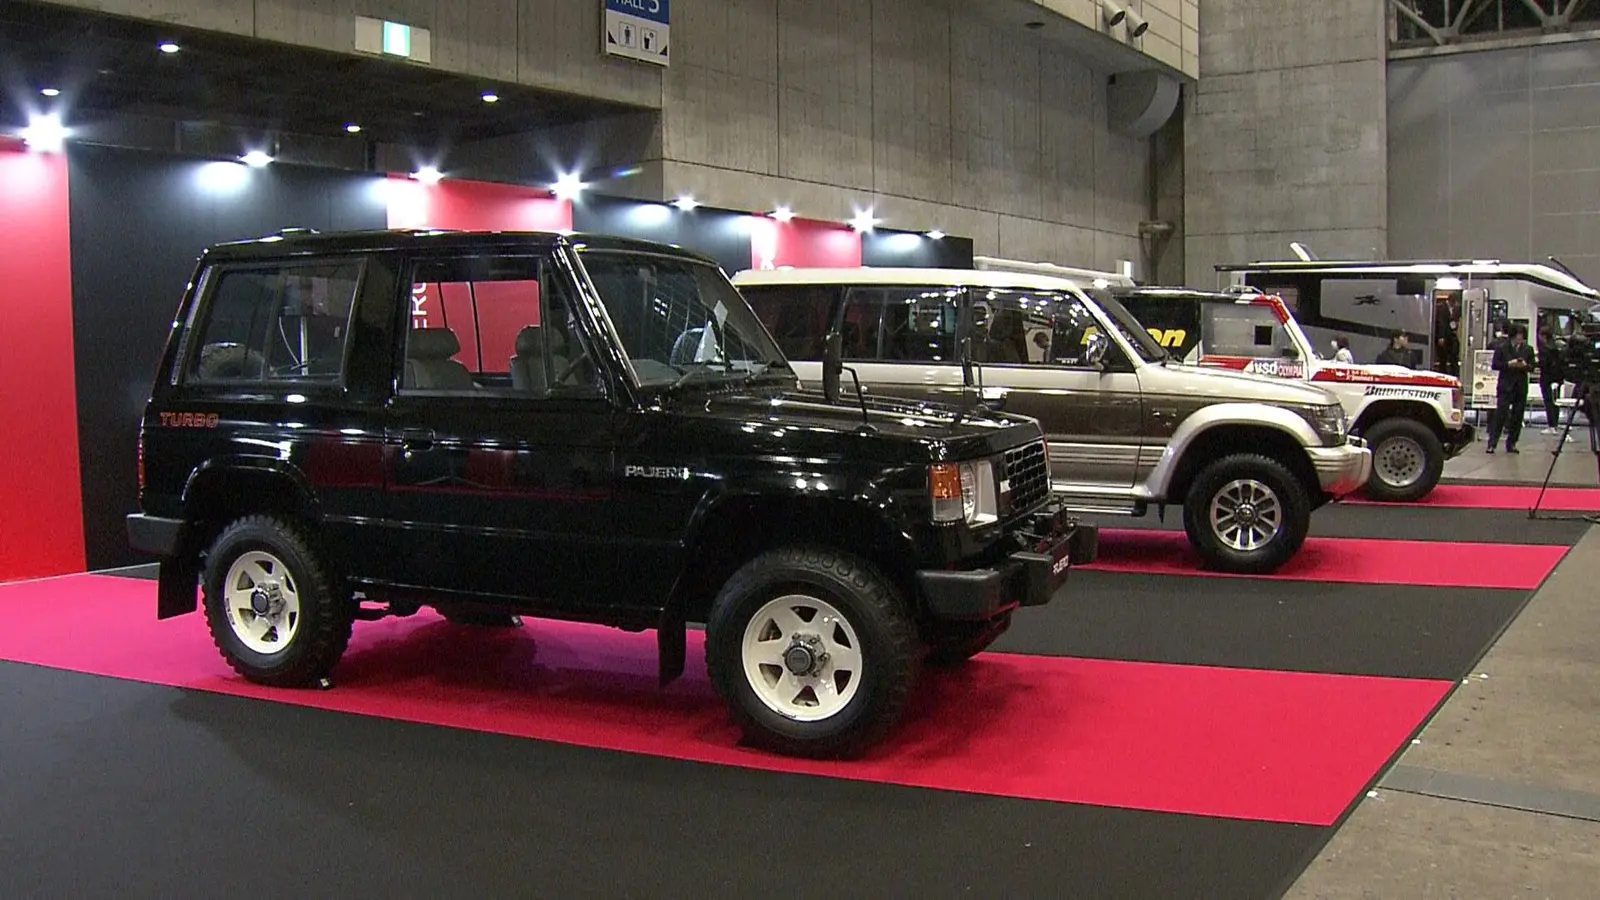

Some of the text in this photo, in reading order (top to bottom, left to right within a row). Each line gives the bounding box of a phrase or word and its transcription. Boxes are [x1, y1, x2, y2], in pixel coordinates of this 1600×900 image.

[1364, 385, 1442, 401] BRIDGESTONE
[160, 411, 219, 428] TURBO
[625, 466, 689, 480] PAJERO
